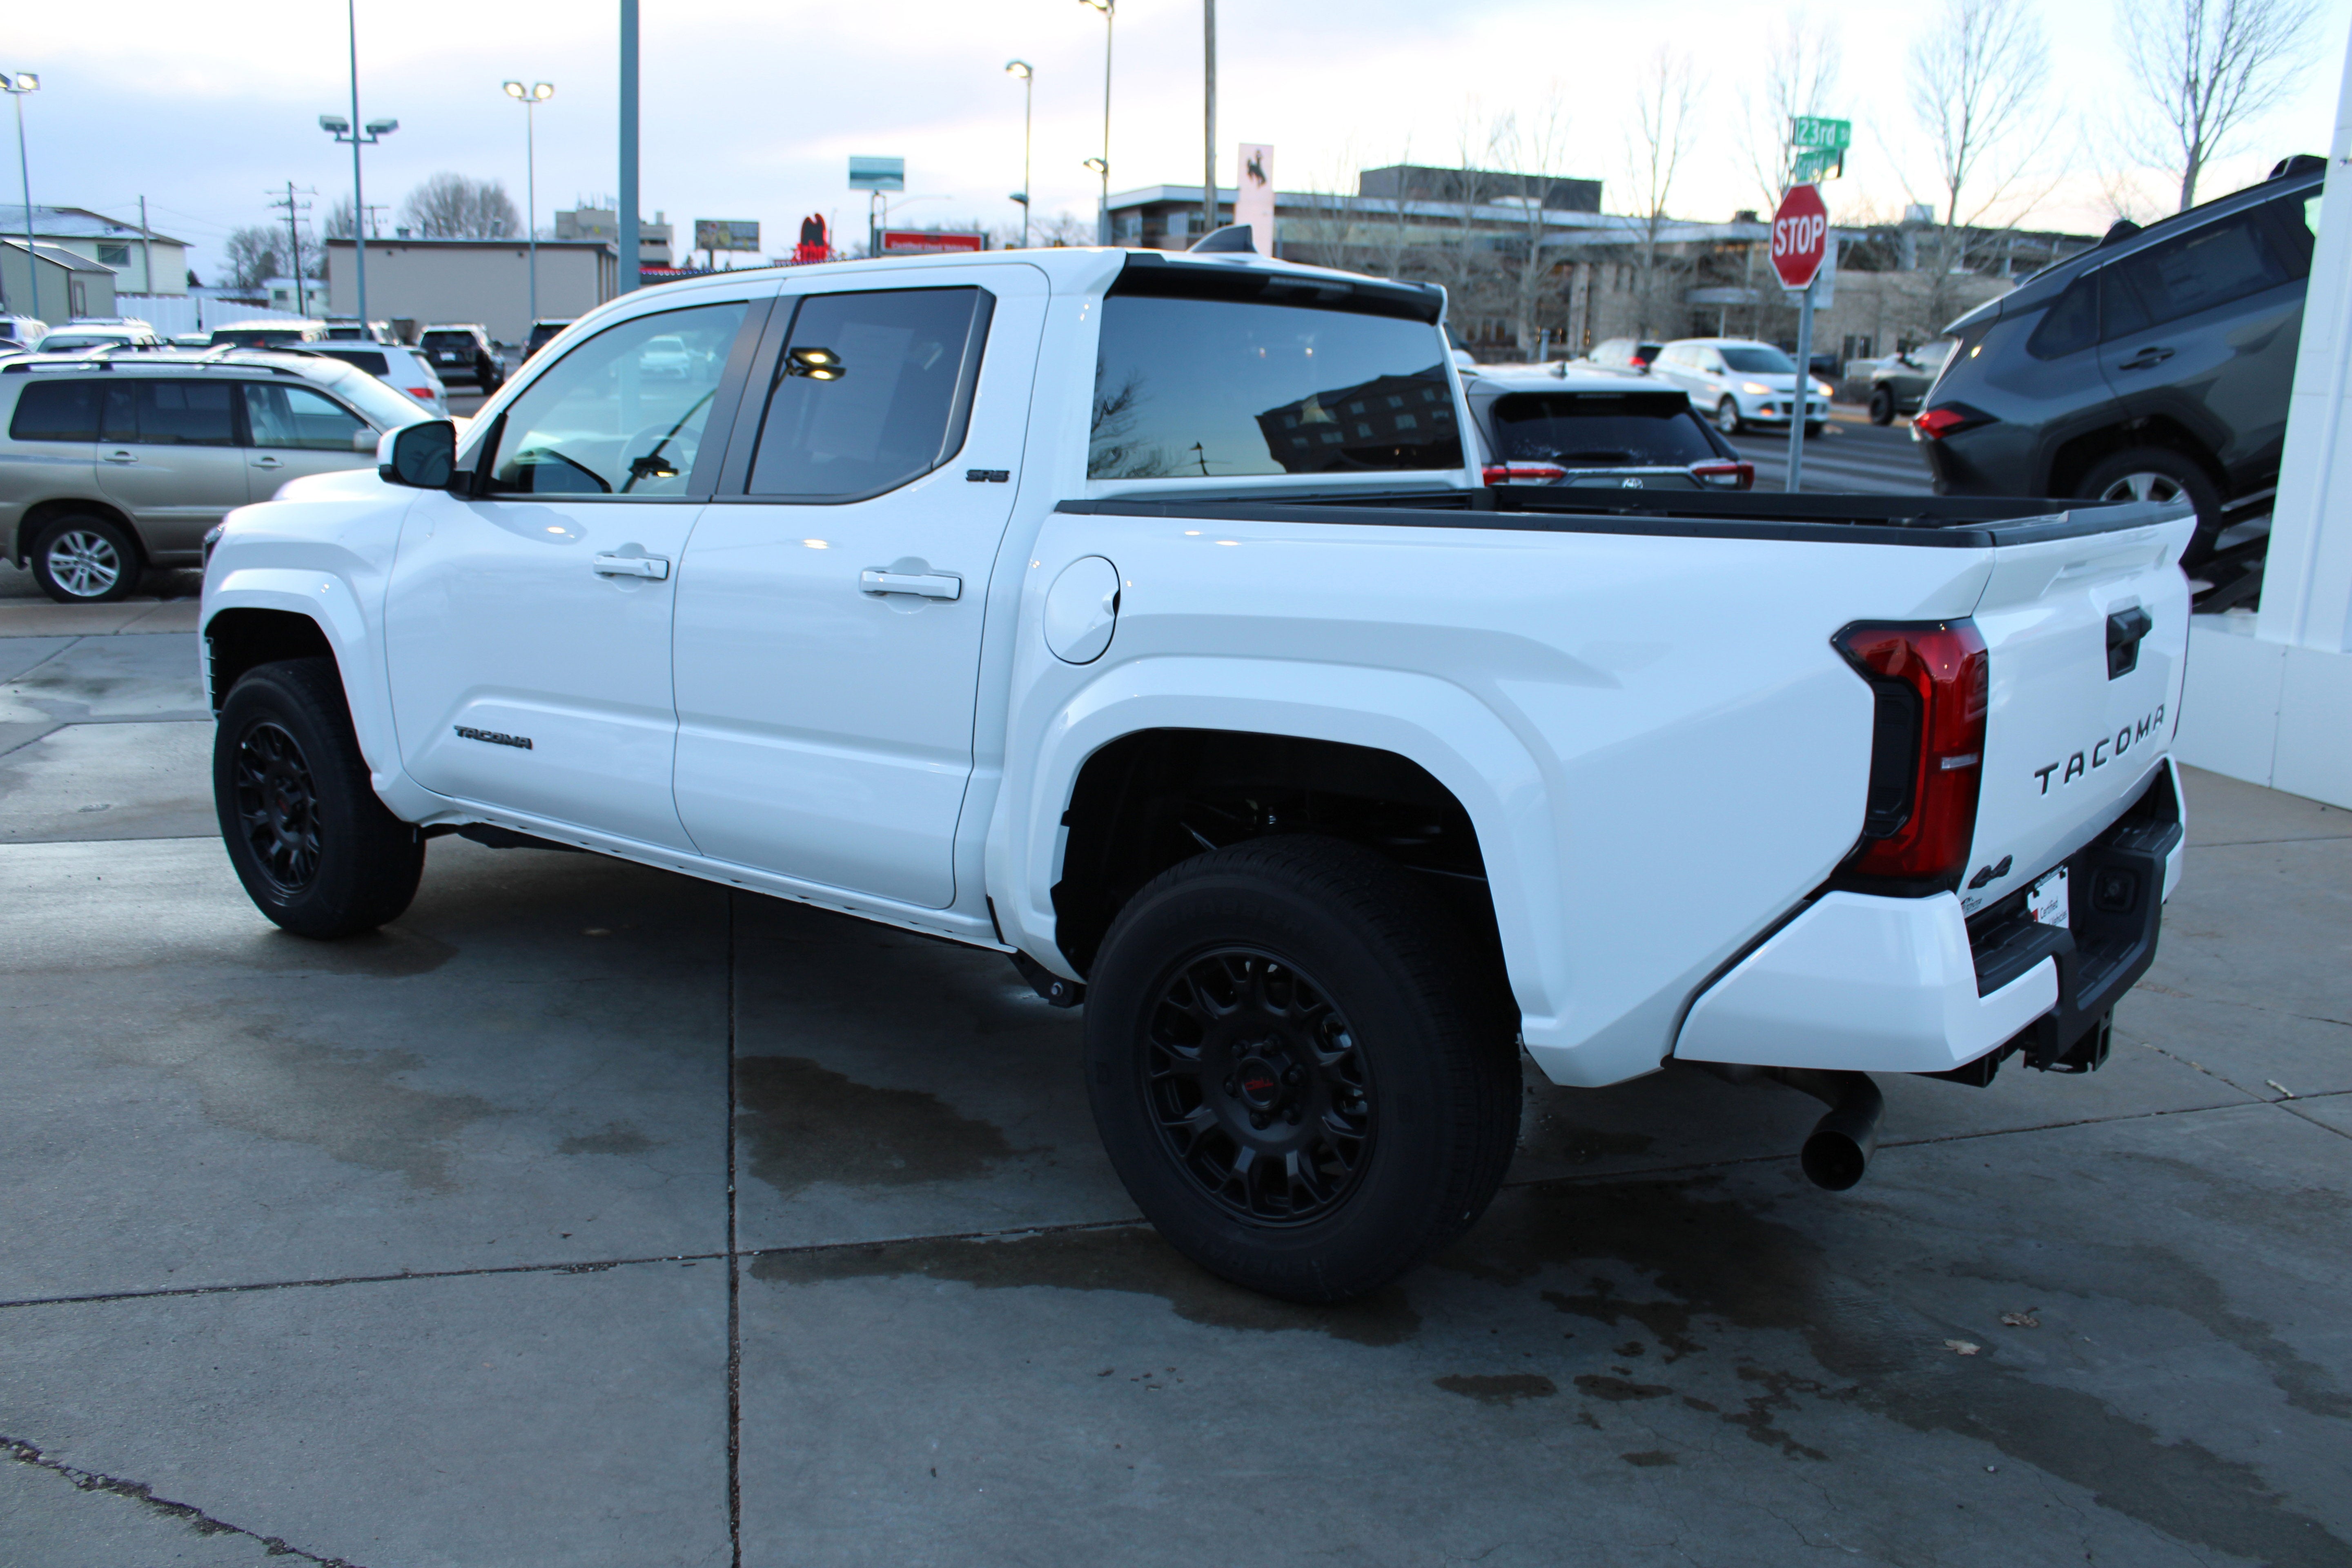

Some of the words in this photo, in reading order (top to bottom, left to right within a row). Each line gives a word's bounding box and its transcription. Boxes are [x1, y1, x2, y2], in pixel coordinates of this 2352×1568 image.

[1799, 119, 1836, 146] 23rd
[1774, 214, 1824, 257] STOP
[966, 470, 1010, 483] SR5
[454, 725, 533, 750] TACOMA
[2034, 703, 2165, 796] TACOMA
